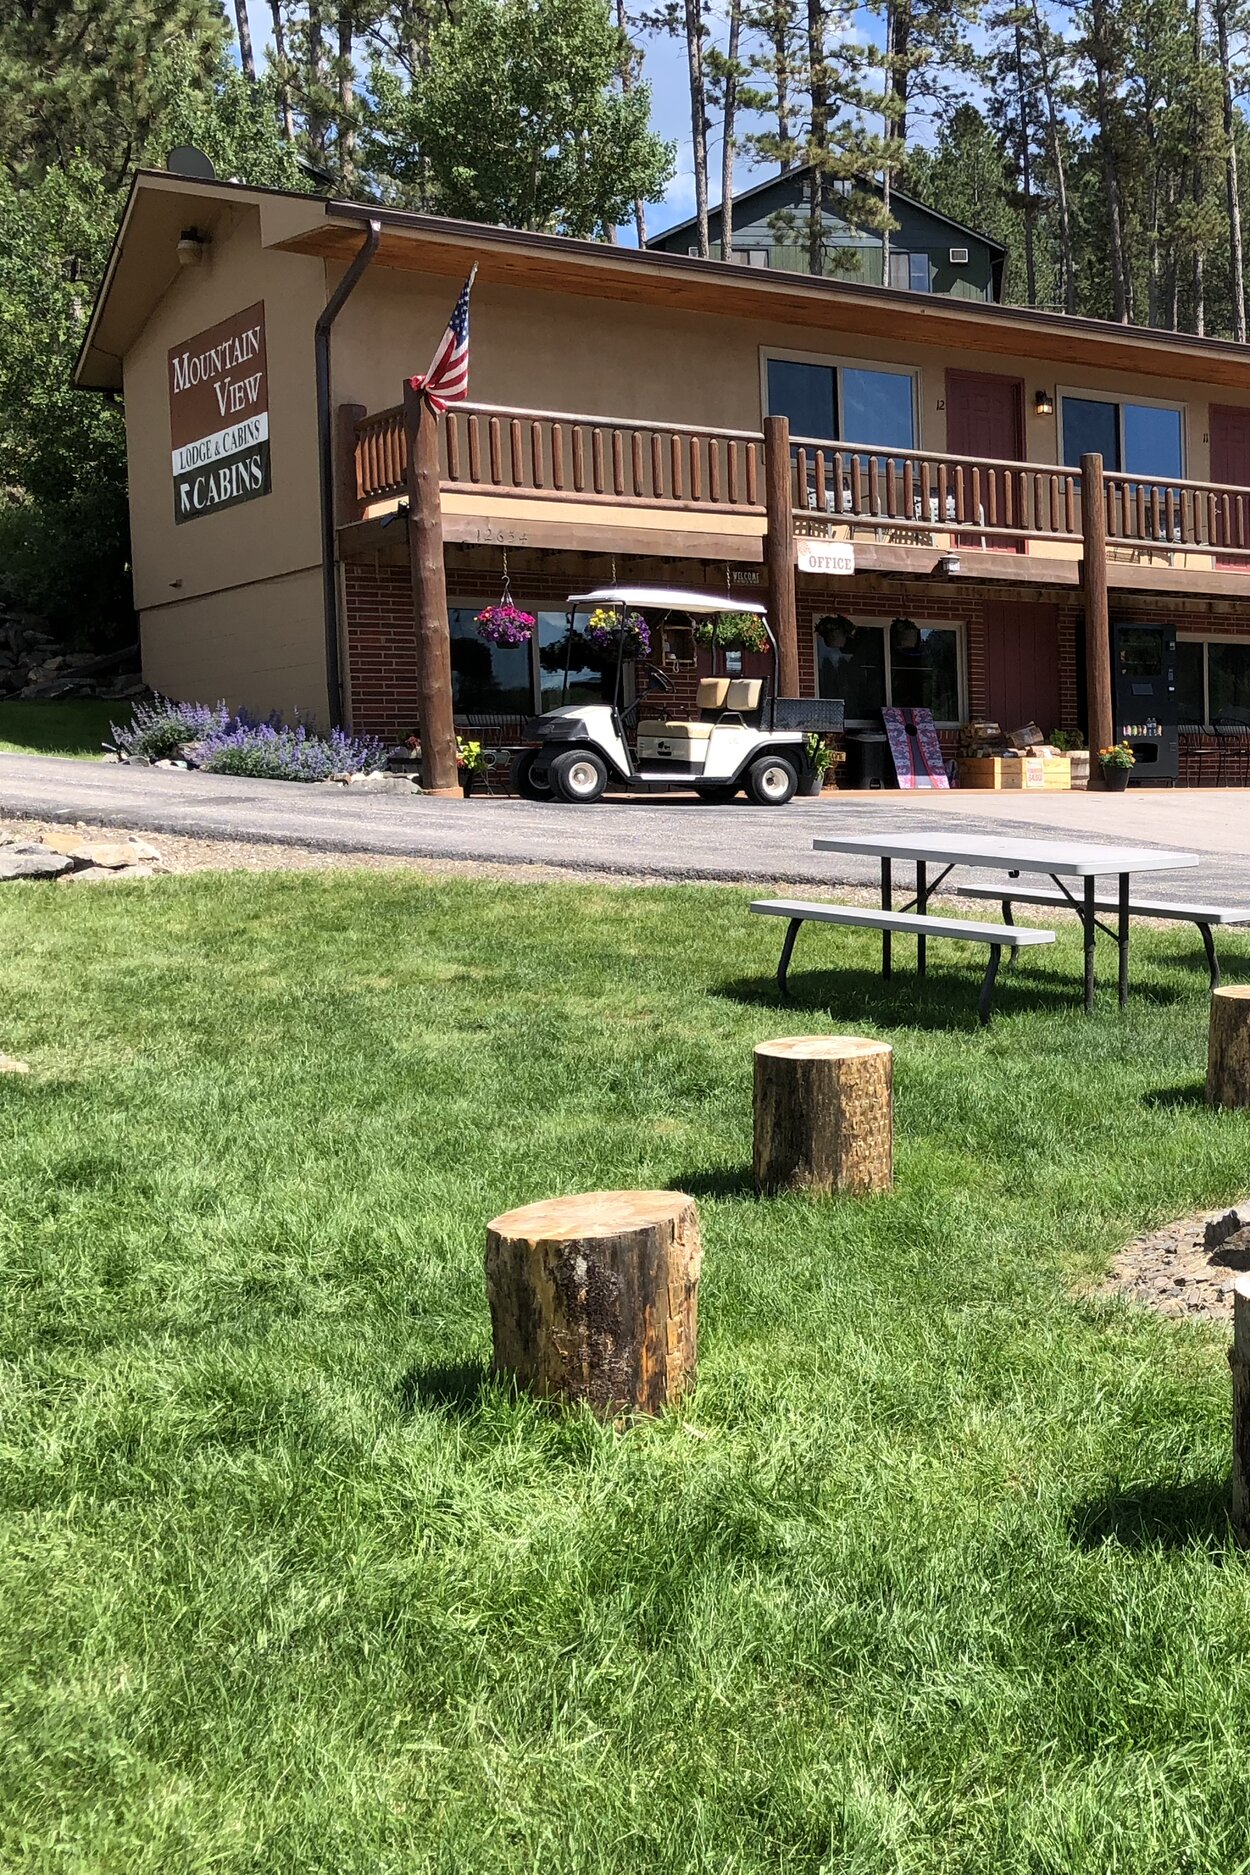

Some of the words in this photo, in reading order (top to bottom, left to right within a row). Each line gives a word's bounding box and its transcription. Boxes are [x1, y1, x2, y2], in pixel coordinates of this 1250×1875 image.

[172, 325, 262, 394] MOUNTAIN
[213, 372, 263, 418] VIEW
[936, 399, 945, 411] 12
[179, 442, 213, 471] LODGE
[213, 440, 221, 456] &
[222, 419, 261, 454] CABINS
[192, 454, 263, 510] CABINS
[732, 571, 760, 582] WELCOME
[808, 555, 852, 571] OFFICE
